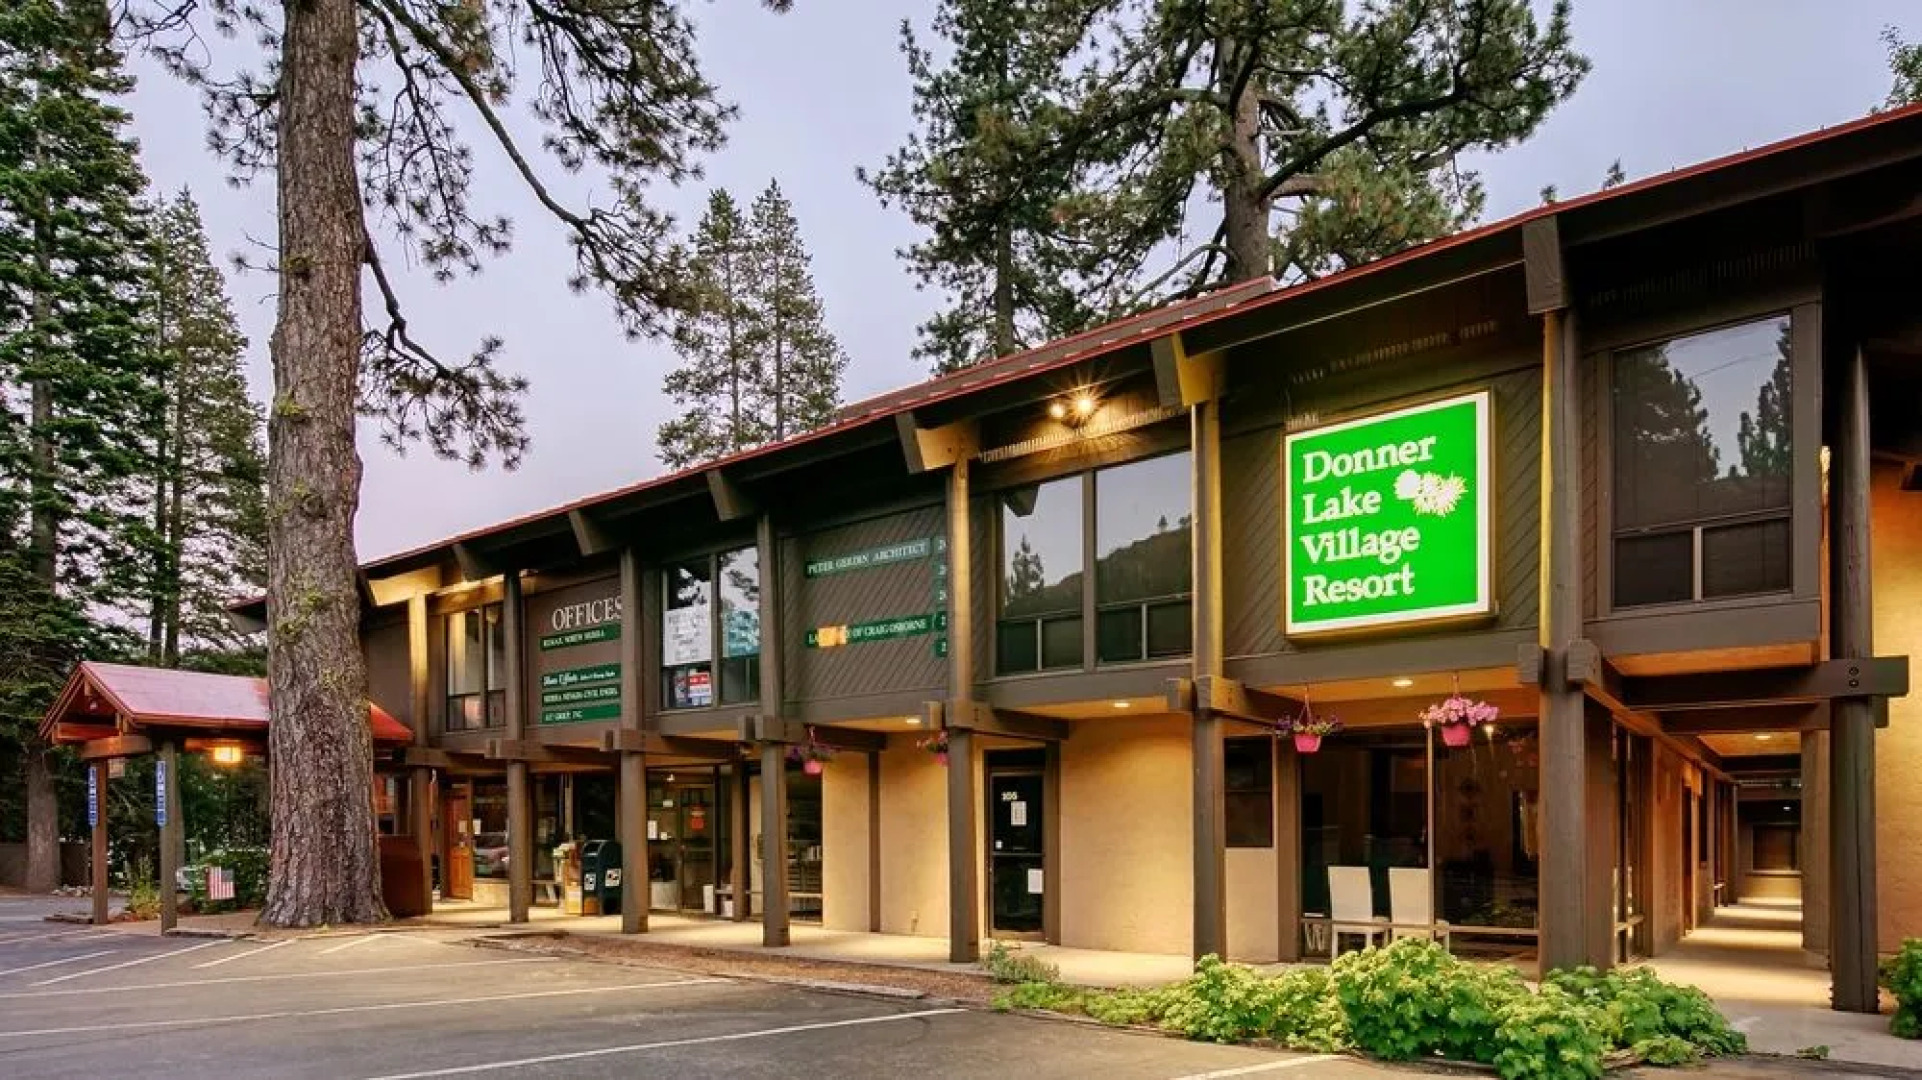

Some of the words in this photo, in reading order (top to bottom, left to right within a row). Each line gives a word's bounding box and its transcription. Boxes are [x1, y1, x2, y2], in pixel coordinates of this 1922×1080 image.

[1302, 435, 1437, 484] Donner
[1302, 486, 1383, 525] Lake
[872, 543, 926, 562] ARCHITECT
[1300, 526, 1422, 565] Village
[1302, 562, 1416, 607] Resort
[552, 595, 622, 631] OFFICES
